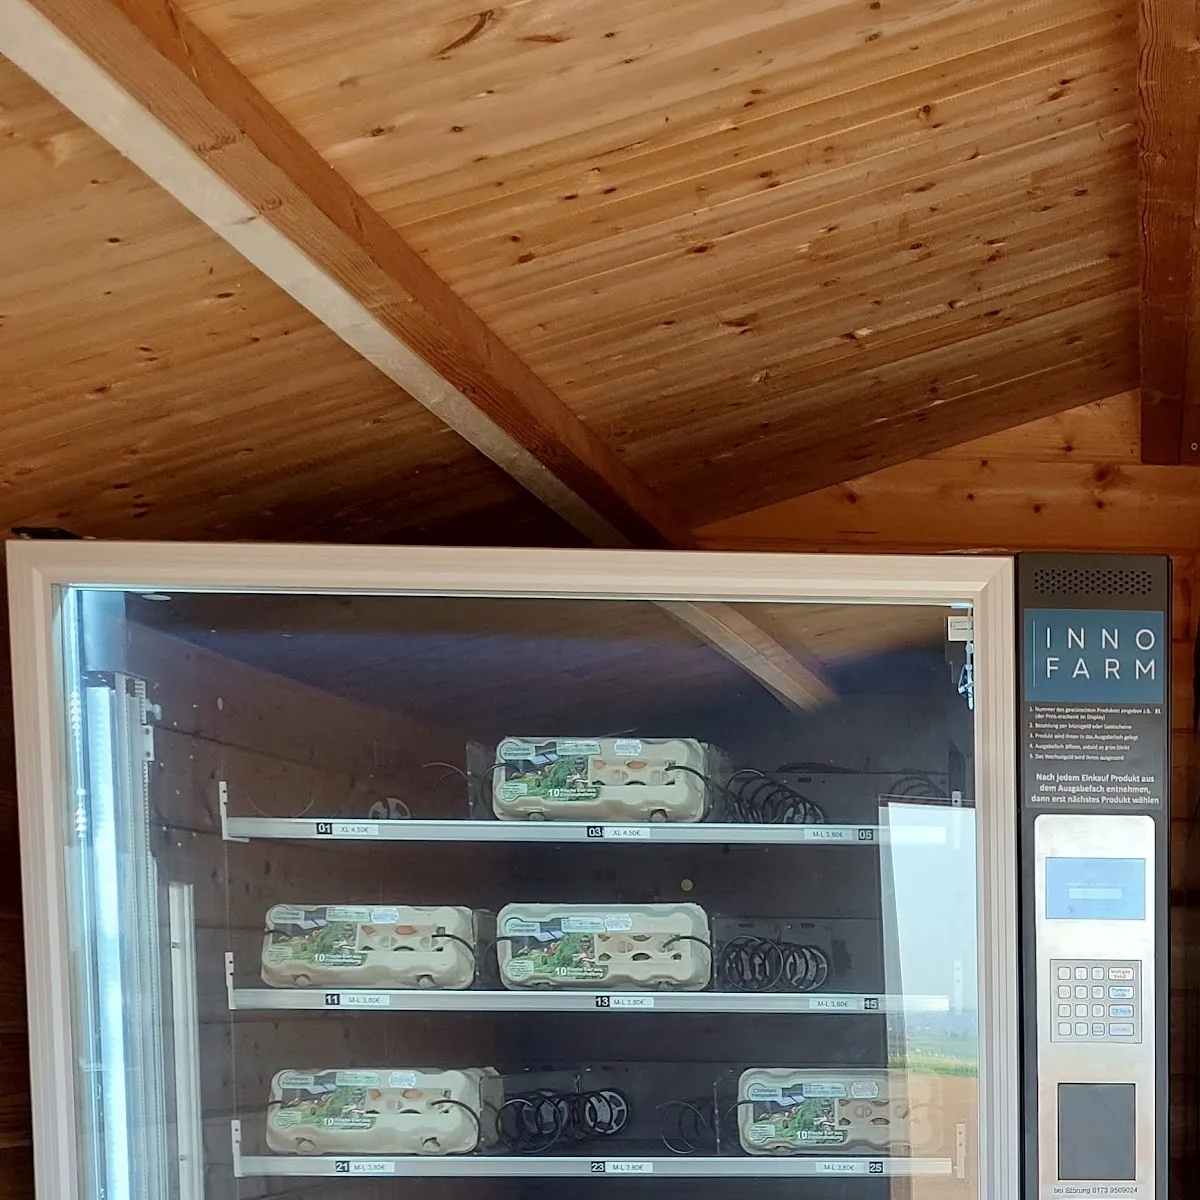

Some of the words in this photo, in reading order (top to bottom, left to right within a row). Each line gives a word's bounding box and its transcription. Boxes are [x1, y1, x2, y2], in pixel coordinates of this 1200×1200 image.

[1046, 627, 1156, 651] INNO
[1046, 657, 1156, 680] FARM
[1036, 773, 1055, 781] Nach
[1056, 773, 1080, 782] jedem
[1081, 774, 1109, 782] Einkauf
[1110, 775, 1140, 783] Produkt
[548, 788, 560, 798] 10
[1040, 784, 1057, 792] dem
[1057, 784, 1105, 793] Ausgabefach
[1106, 785, 1151, 794] entnehmen,
[1031, 795, 1050, 803] dann
[1051, 795, 1066, 803] erst
[1068, 795, 1100, 803] nächstes
[1101, 796, 1131, 804] Produkt
[1132, 796, 1160, 804] wählen
[318, 823, 331, 833] 01
[588, 827, 601, 836] 03
[859, 830, 872, 840] 05
[314, 953, 325, 963] 10
[556, 967, 567, 976] 10
[326, 994, 339, 1004] 11
[595, 997, 609, 1006] 13
[865, 999, 877, 1009] 15
[797, 1131, 808, 1140] 10
[335, 1161, 349, 1172] 21
[591, 1162, 605, 1171] 23
[869, 1163, 882, 1172] 25
[1065, 1187, 1091, 1195] Störung
